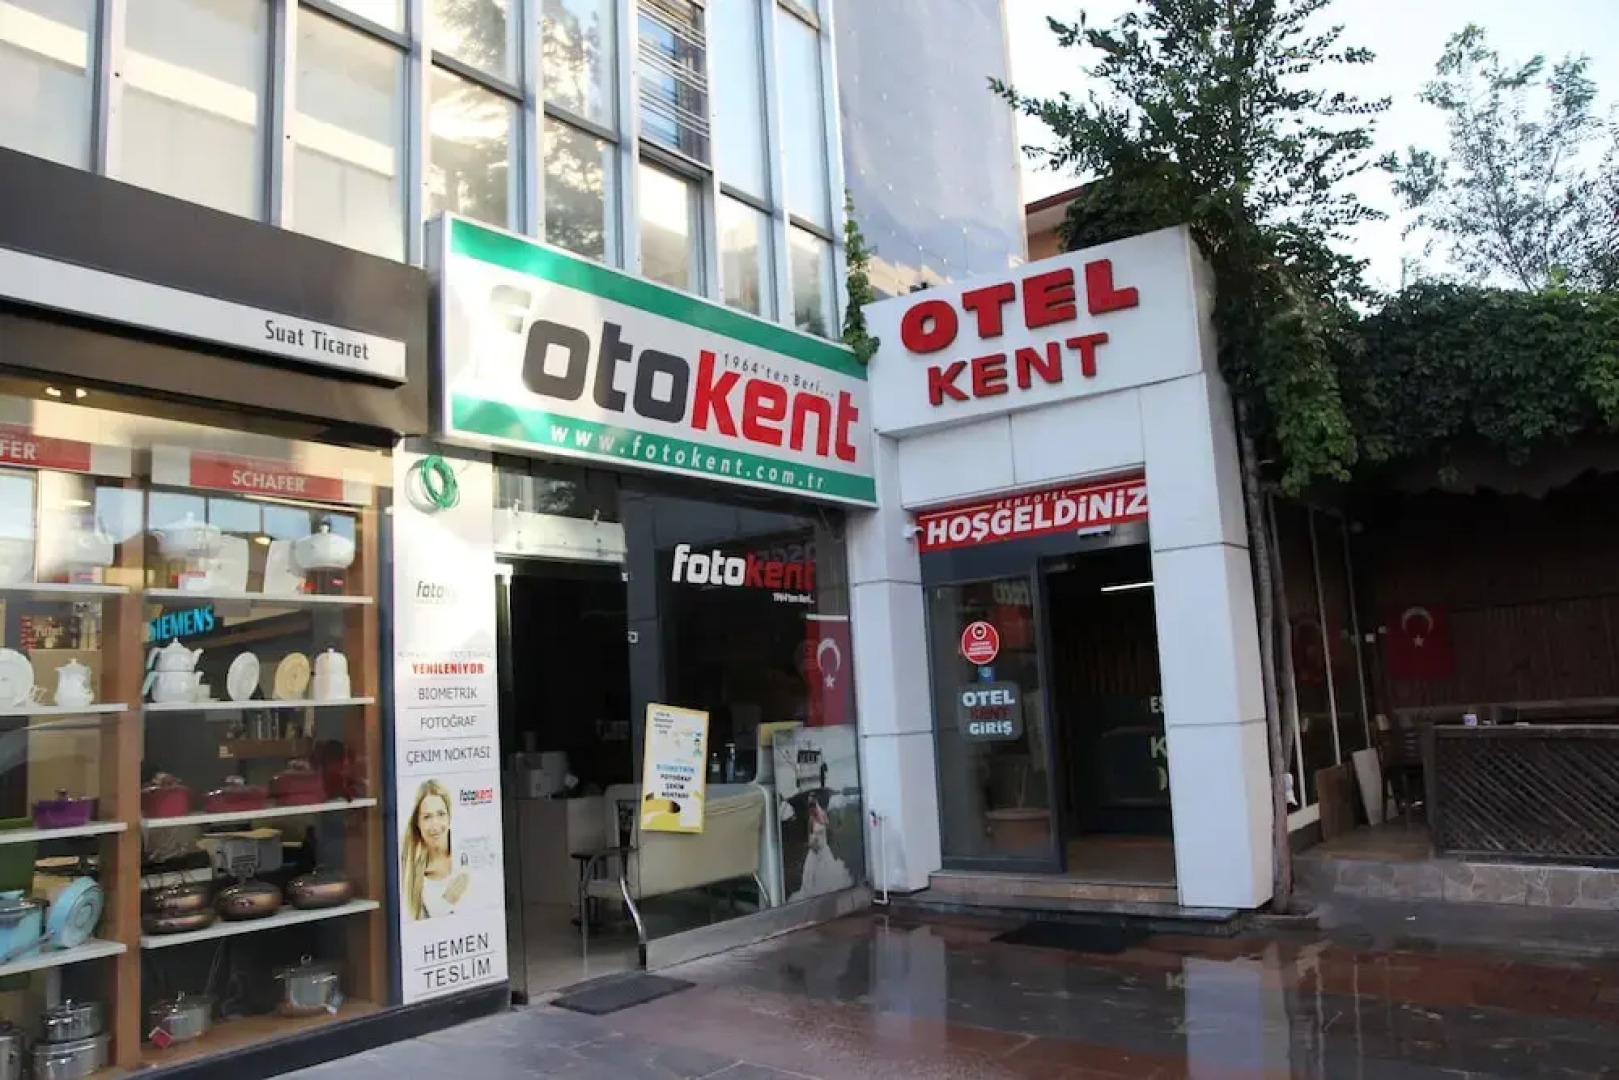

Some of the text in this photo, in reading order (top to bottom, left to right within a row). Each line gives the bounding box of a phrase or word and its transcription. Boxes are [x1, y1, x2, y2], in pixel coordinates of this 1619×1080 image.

[900, 258, 1140, 355] OTEL
[265, 319, 369, 360] Suat Ticaret
[927, 331, 1110, 407] KENT
[551, 424, 826, 490] www.fotokent.com.tr
[232, 469, 305, 493] SCHAFER
[671, 543, 815, 591] fotokent
[148, 604, 215, 642] SIEMENS
[962, 690, 1016, 707] OTEL
[420, 713, 478, 730] FOTOĞRAF
[423, 932, 488, 962] HEMEN
[422, 957, 491, 989] TESLİM
